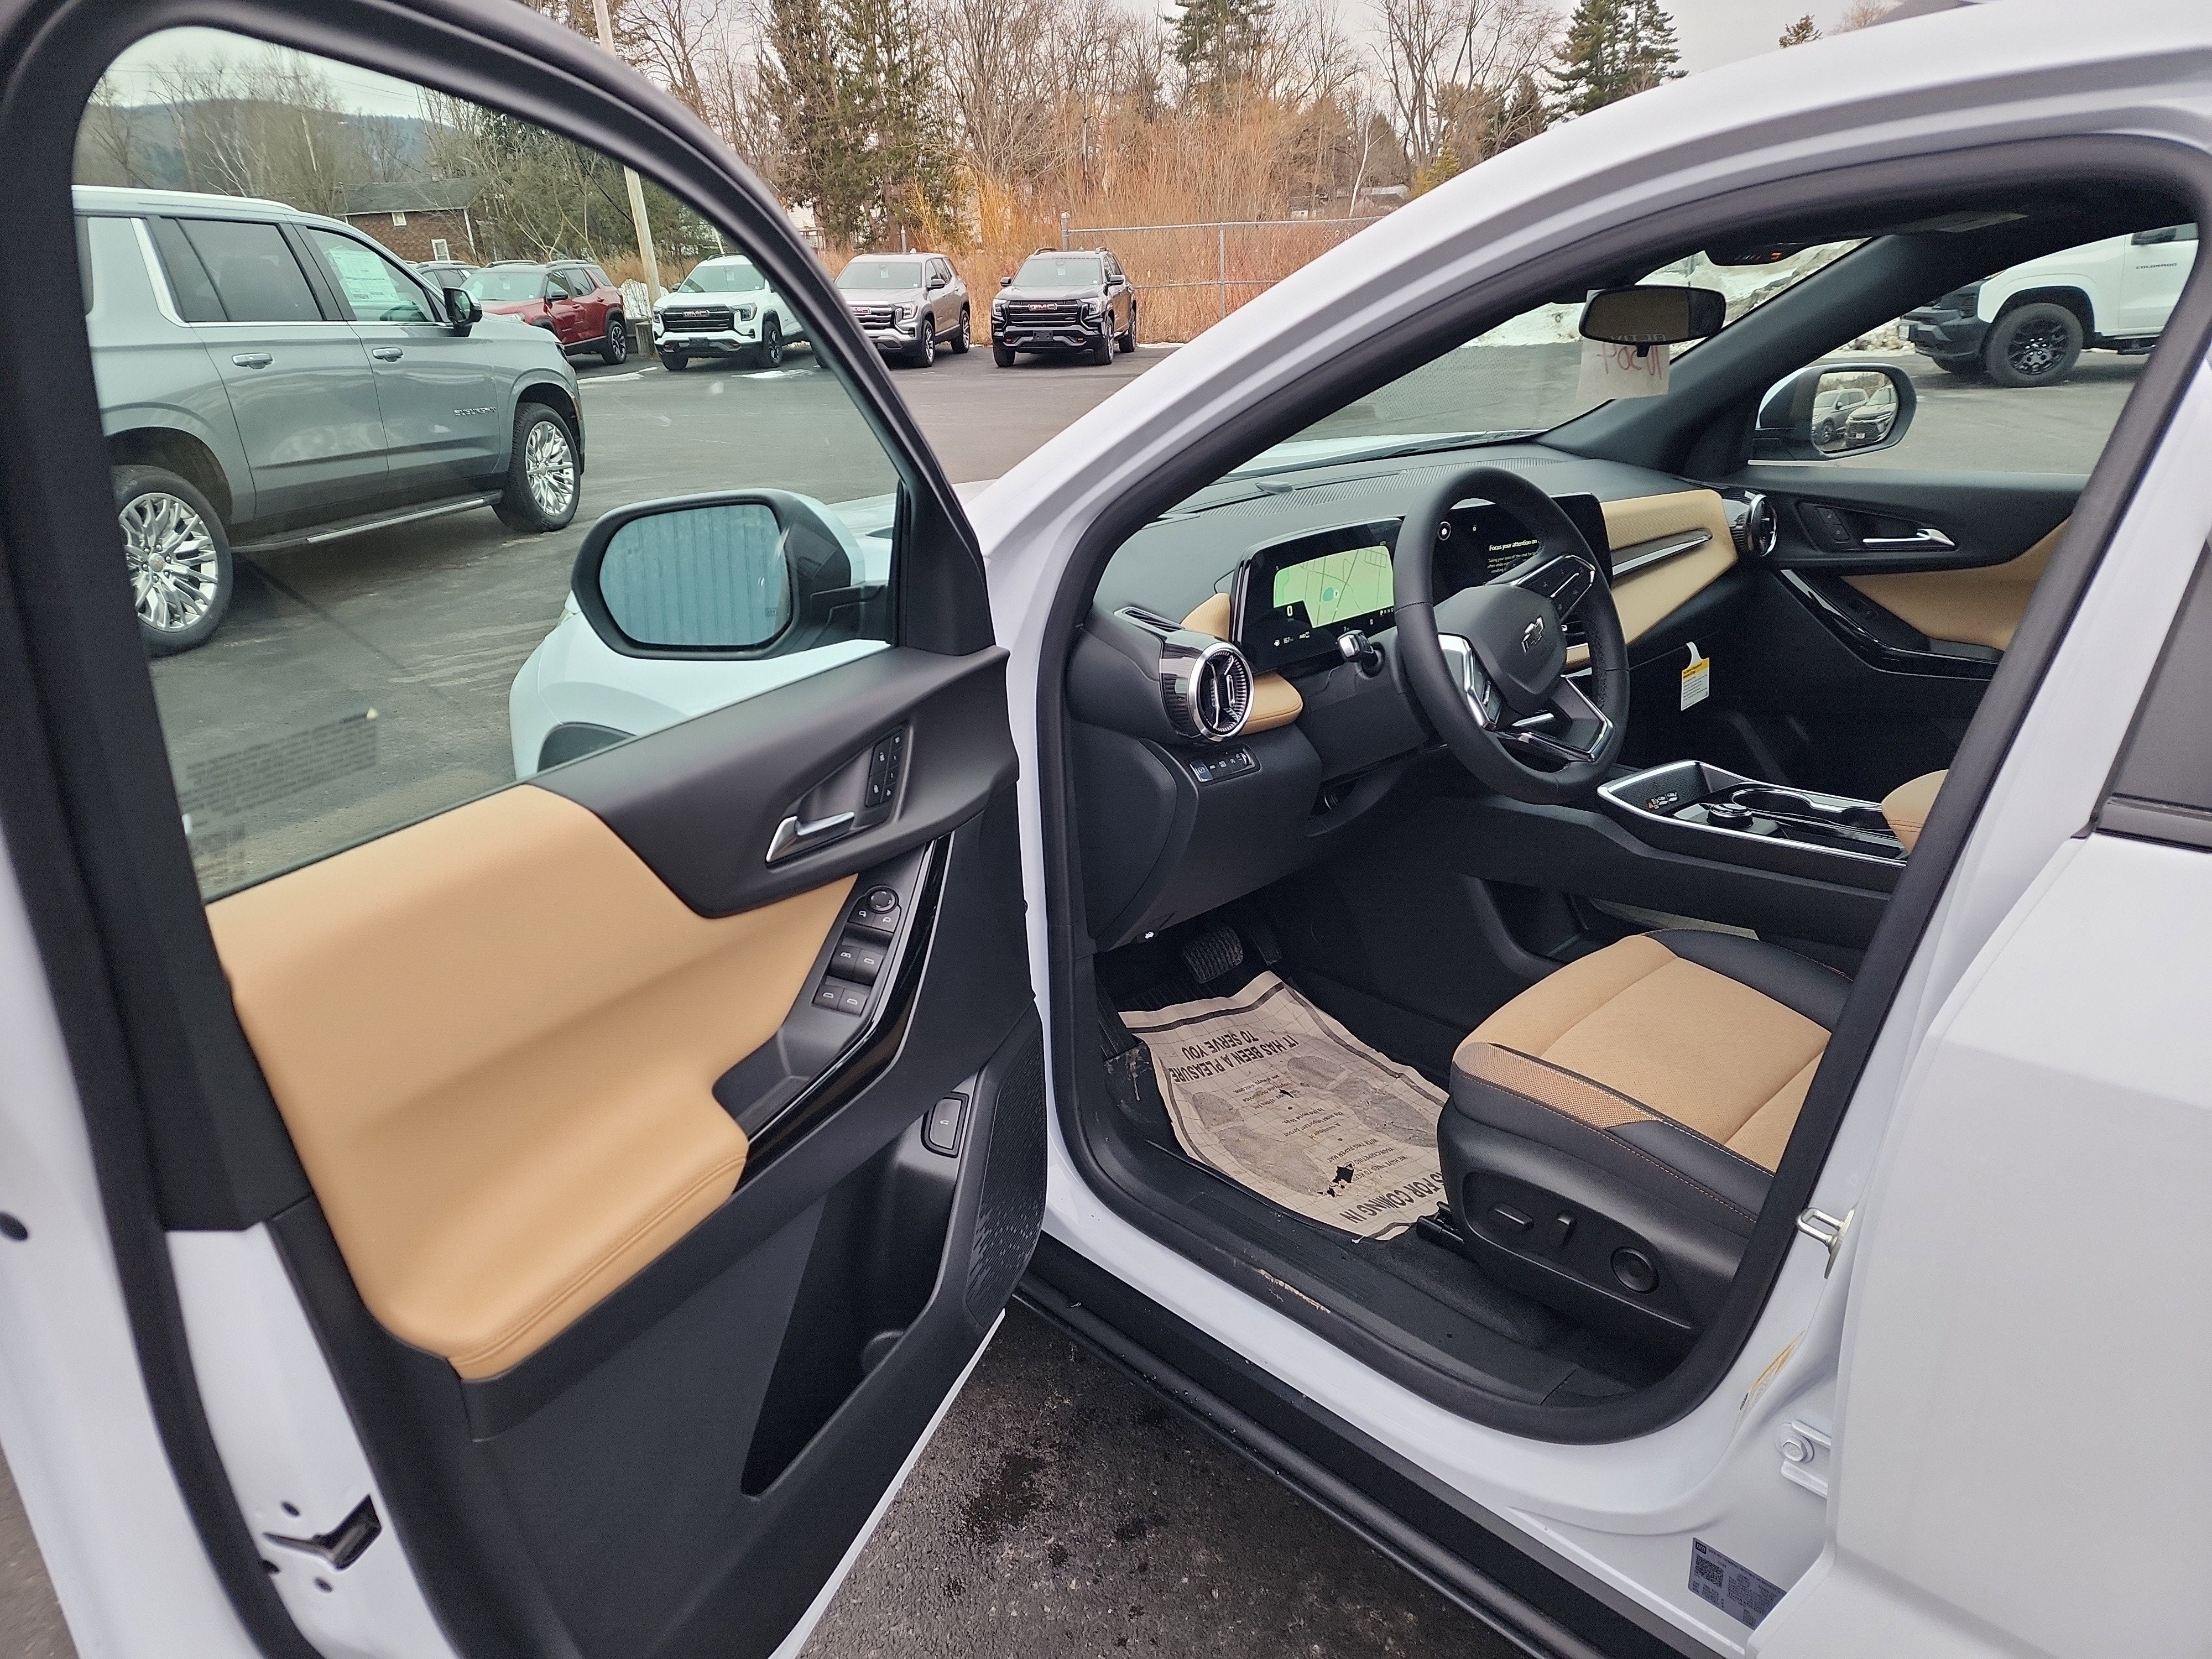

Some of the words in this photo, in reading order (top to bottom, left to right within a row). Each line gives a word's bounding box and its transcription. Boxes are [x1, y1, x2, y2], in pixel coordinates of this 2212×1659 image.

[1203, 1033, 1243, 1054] SERVE
[1239, 1030, 1259, 1044] TO
[1282, 1035, 1299, 1048] IT
[1181, 1044, 1209, 1061] YOU
[1259, 1039, 1285, 1056] HAS
[1220, 1053, 1234, 1068] A
[1229, 1046, 1263, 1067] BEEN
[1168, 1058, 1225, 1083] PLEASURE
[1326, 1154, 1338, 1163] MAT
[1338, 1145, 1354, 1157] PAPER
[1354, 1151, 1381, 1165] CARPETING
[1384, 1159, 1400, 1167] HAVE
[1403, 1177, 1439, 1198] FOR
[1356, 1189, 1415, 1217] COMING
[1338, 1209, 1367, 1224] IN
